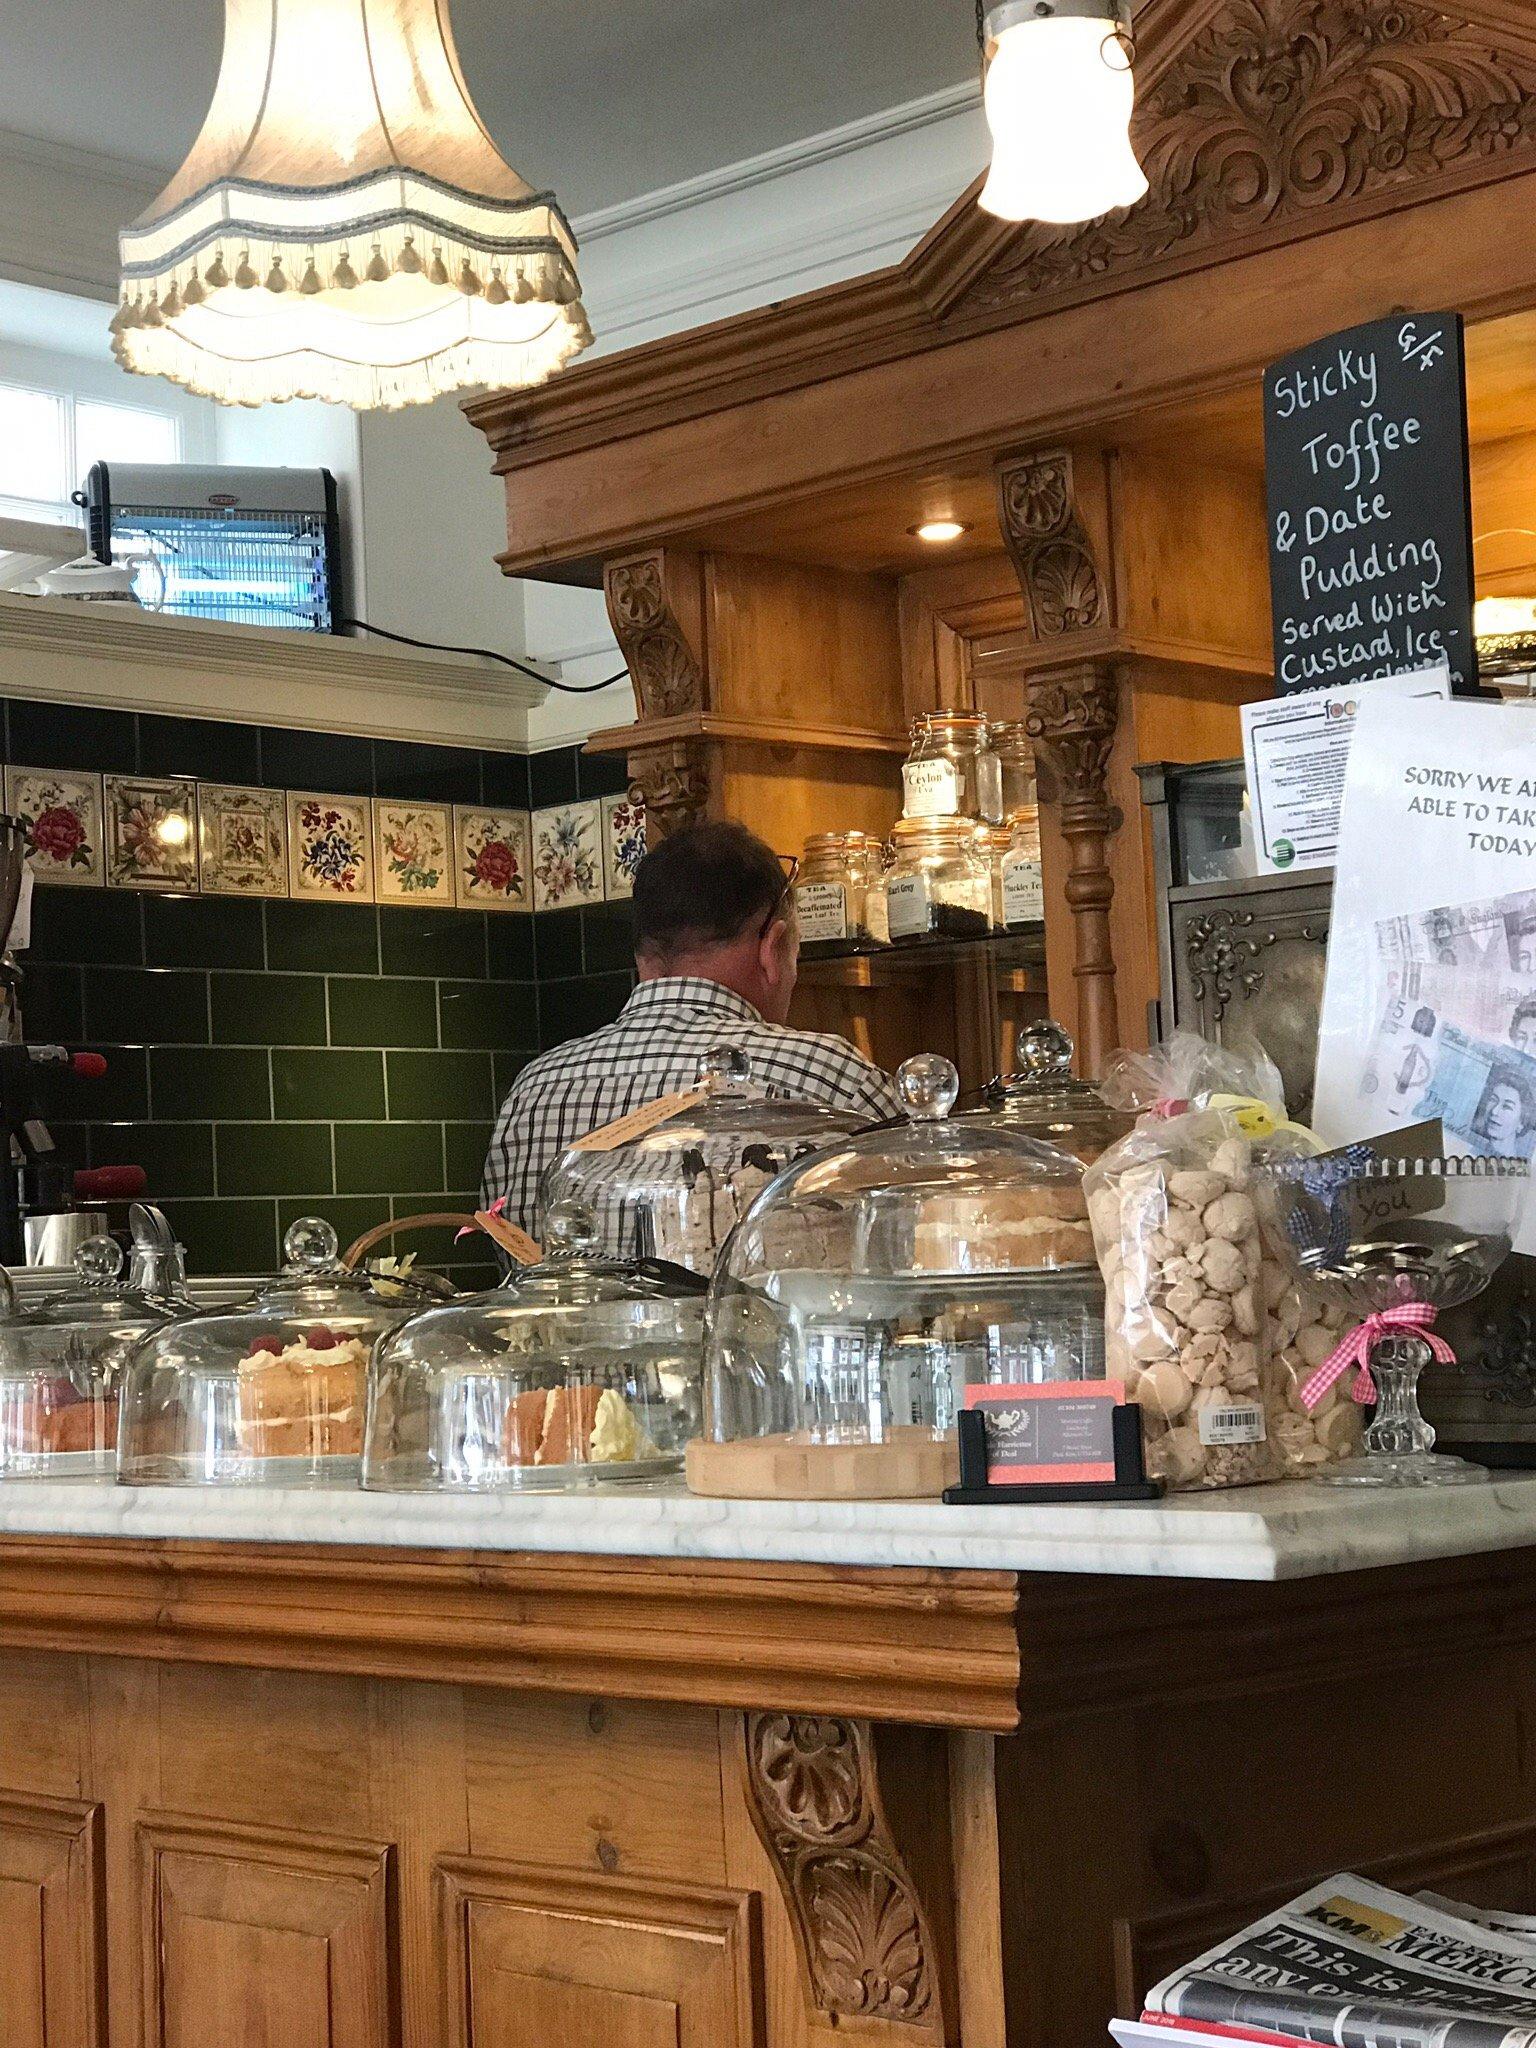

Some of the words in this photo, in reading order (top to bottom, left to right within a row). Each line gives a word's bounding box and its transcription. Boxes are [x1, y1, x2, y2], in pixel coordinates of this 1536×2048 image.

[1275, 349, 1378, 418] Sticky
[1301, 413, 1421, 490] Toffee
[1276, 511, 1297, 552] &
[1305, 493, 1391, 545] Date
[1300, 538, 1442, 600] Pudding
[1281, 601, 1364, 644] Served
[1371, 588, 1446, 625] With
[1280, 629, 1400, 684] Custard,
[908, 773, 943, 787] Ceylon
[1404, 766, 1473, 789] SORRY
[1477, 775, 1513, 795] WE
[1407, 796, 1457, 818] ABLE
[1463, 802, 1490, 821] TO
[1468, 832, 1536, 857] TODAY
[900, 884, 915, 894] Grey
[1409, 1925, 1466, 1949] EAST
[1209, 1955, 1309, 1989] any
[1254, 1929, 1359, 1977] This
[1355, 1970, 1409, 1991] is
